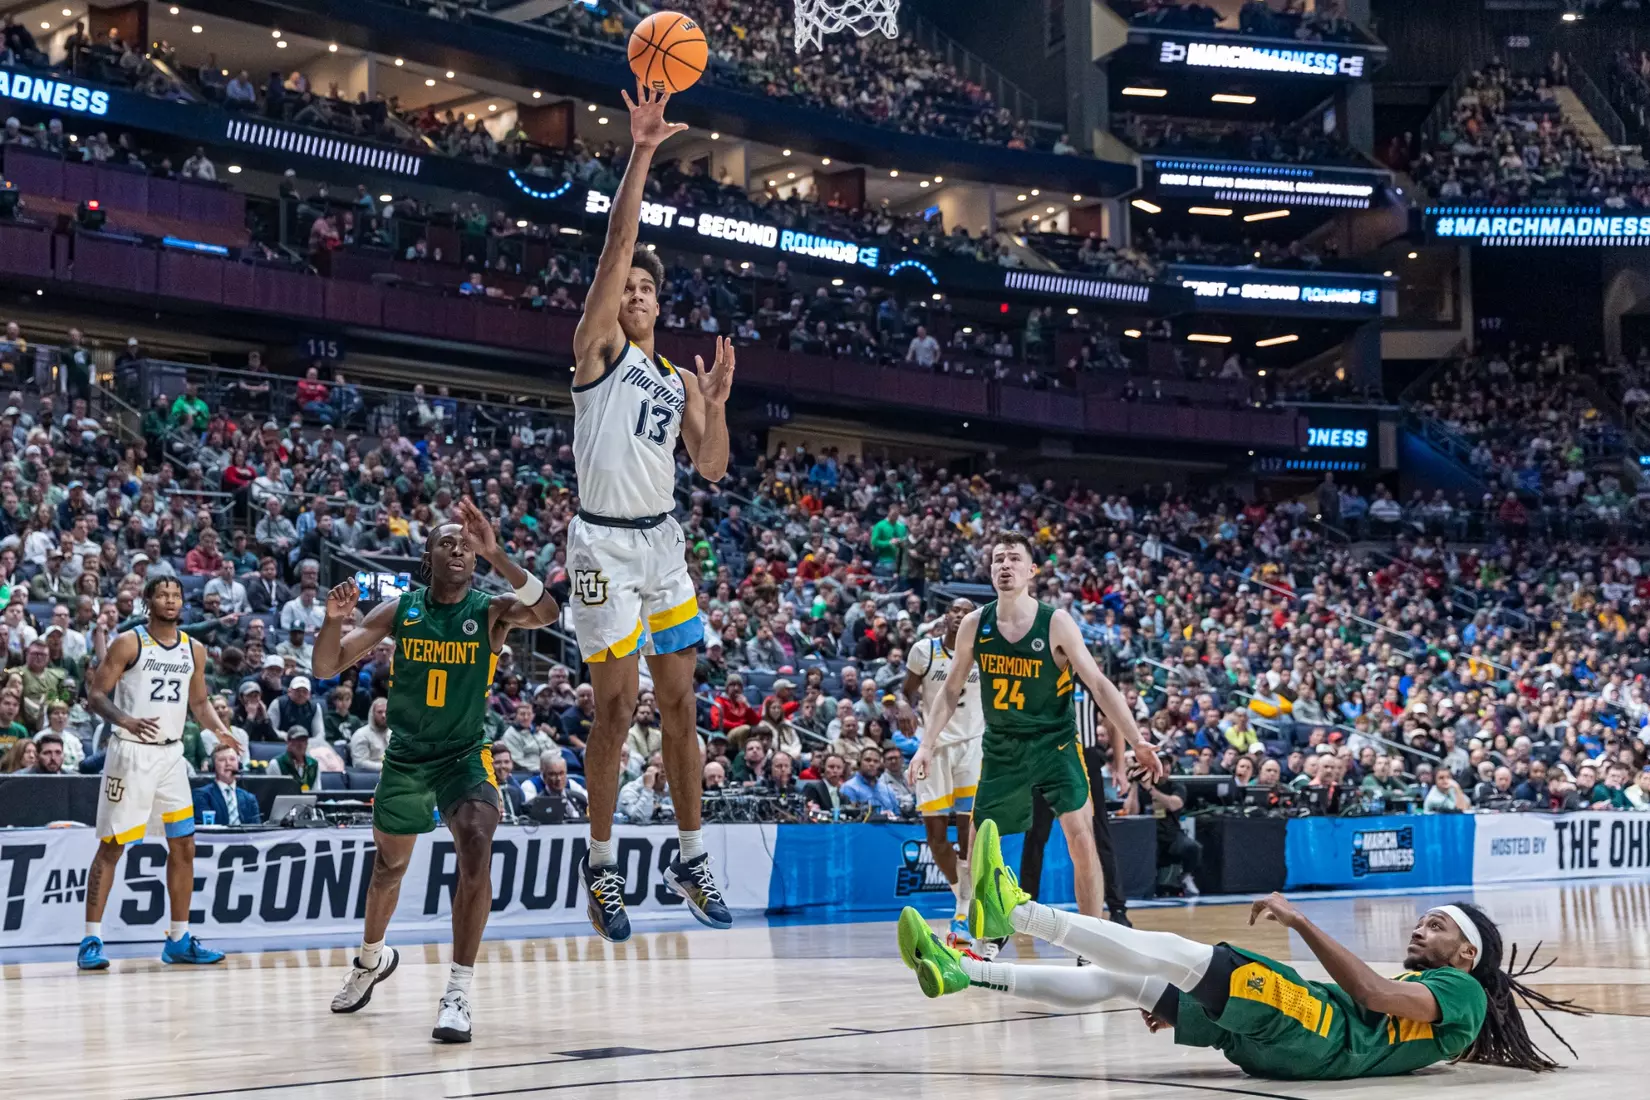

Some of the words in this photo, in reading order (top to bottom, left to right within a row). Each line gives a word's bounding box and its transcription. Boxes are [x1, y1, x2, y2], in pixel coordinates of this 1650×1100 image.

[697, 213, 778, 248] SECOND
[780, 229, 859, 265] ROUNDS
[1436, 217, 1650, 236] #MARCHMADNESS
[307, 339, 338, 358] 115
[634, 398, 674, 446] 13
[766, 402, 790, 419] 116
[574, 569, 608, 606] MU
[402, 637, 480, 664] VERMONT
[142, 658, 192, 675] Marquette
[980, 653, 1042, 678] VERMONT
[150, 677, 182, 703] 23
[426, 668, 448, 708] 0
[993, 678, 1025, 710] 24
[1362, 831, 1398, 850] MARCH
[1491, 838, 1531, 856] HOSTED
[1533, 837, 1547, 854] BY
[1554, 819, 1602, 869] THE
[1368, 848, 1414, 867] MADNESS
[42, 868, 88, 904] AN
[119, 841, 378, 925] SECON
